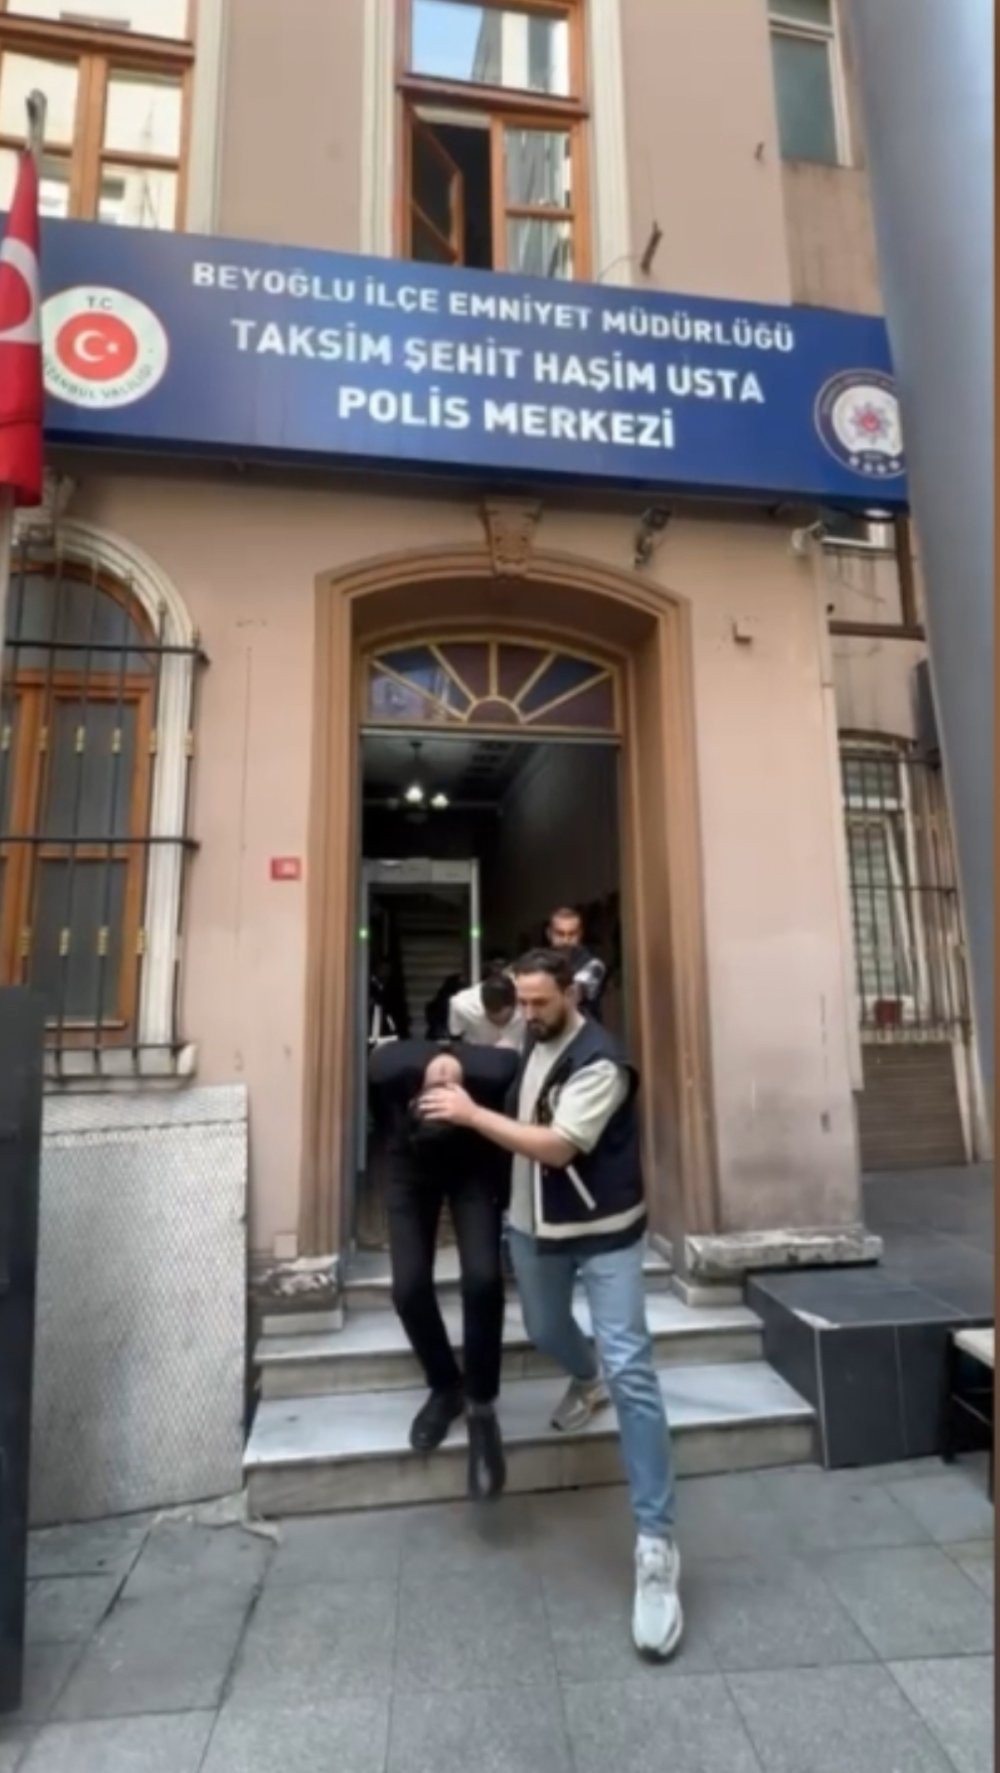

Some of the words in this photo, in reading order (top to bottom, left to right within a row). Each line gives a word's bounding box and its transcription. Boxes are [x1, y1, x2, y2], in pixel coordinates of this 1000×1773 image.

[192, 261, 355, 304] BEYOĞLU
[365, 276, 438, 313] İLÇE
[449, 291, 591, 331] EMNİYET
[602, 308, 795, 353] MÜDÜRLÜĞÜ
[231, 319, 392, 366] TAKSİM
[404, 338, 523, 380] ŞEHİT
[533, 350, 657, 394] HAŞİM
[666, 363, 766, 404] USTA
[338, 385, 471, 430] POLİS
[483, 399, 676, 450] MERKEZİ
